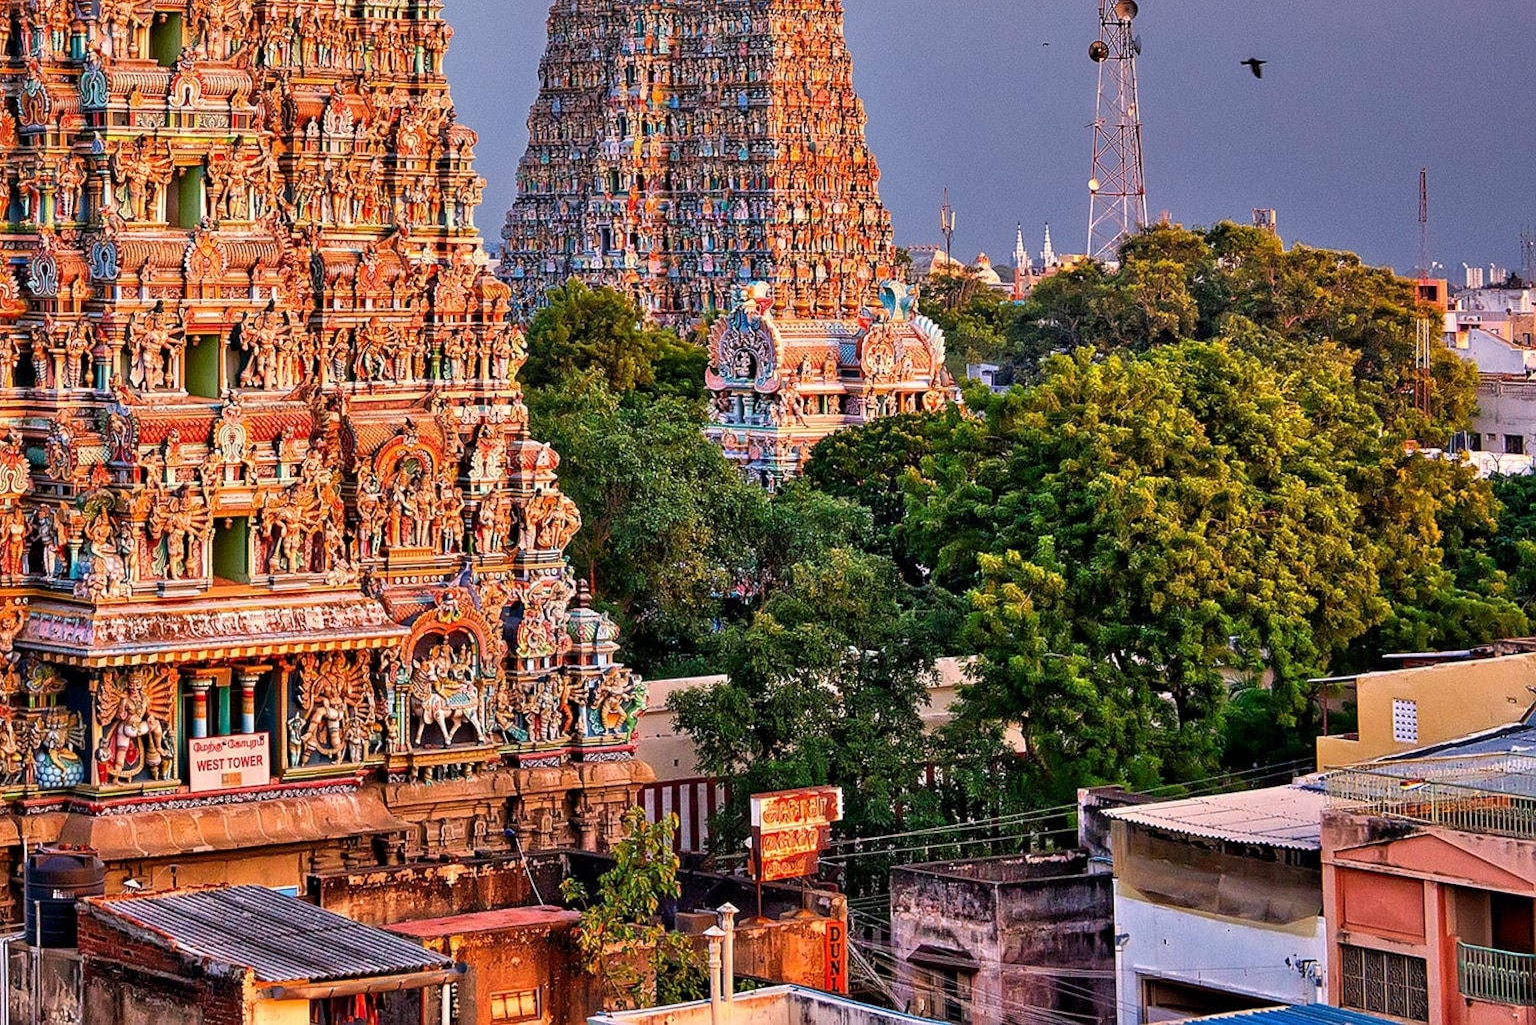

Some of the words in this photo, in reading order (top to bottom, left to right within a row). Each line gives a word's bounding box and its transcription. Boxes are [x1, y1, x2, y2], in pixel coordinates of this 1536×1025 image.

[193, 741, 223, 754] மேற்கு
[227, 735, 265, 750] கோபுரம்
[196, 758, 225, 772] WEST
[226, 755, 264, 769] TOWER
